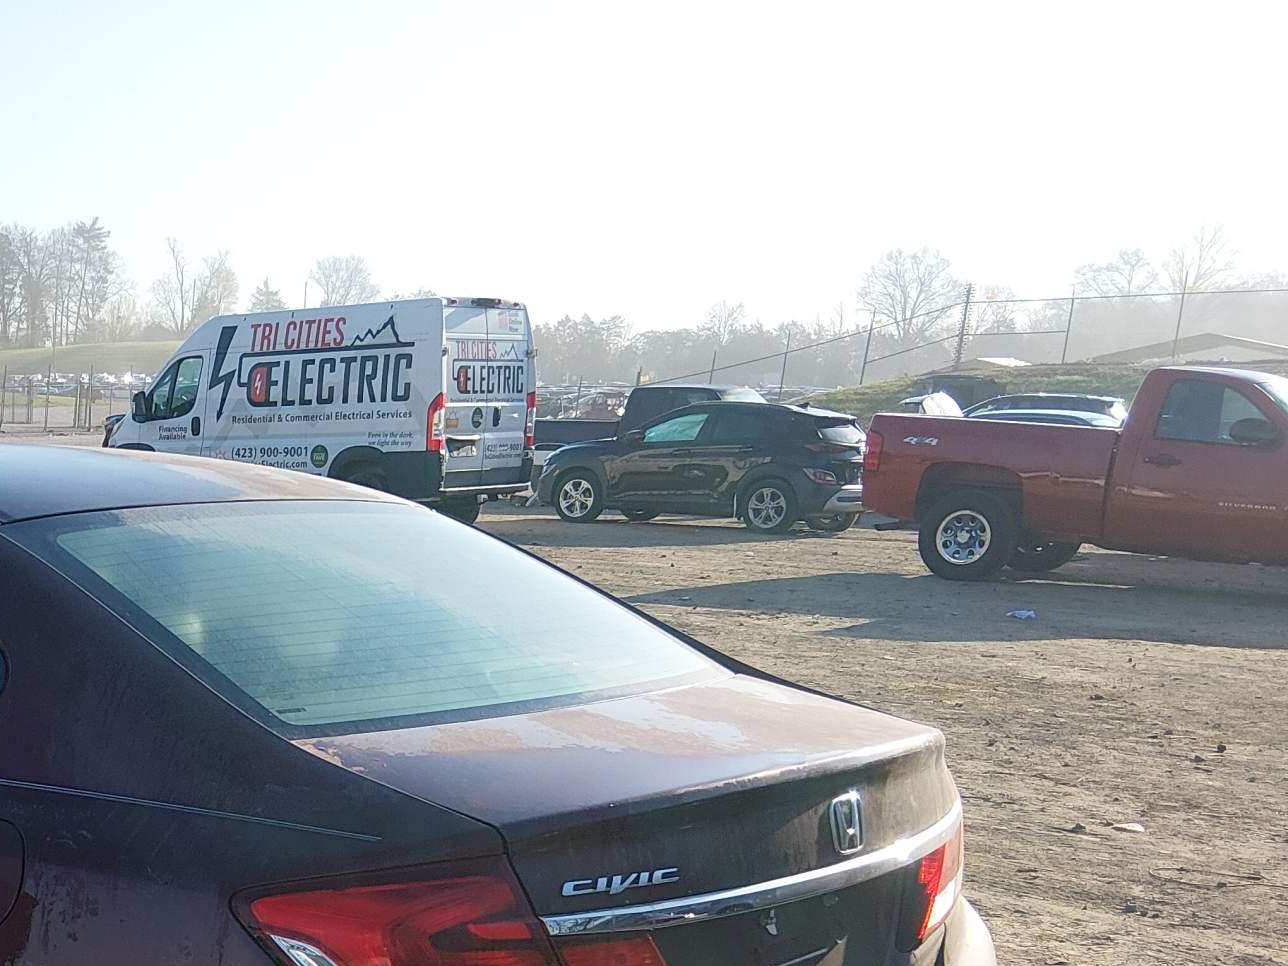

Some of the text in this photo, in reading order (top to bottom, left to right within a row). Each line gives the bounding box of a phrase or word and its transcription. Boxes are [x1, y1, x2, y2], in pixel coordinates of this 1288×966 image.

[250, 316, 347, 351] TRI CITIES
[456, 341, 497, 360] TRI CITIES
[247, 353, 413, 407] ELECTRIC
[457, 365, 523, 394] ELECTRIC
[232, 408, 412, 425] Residential & Commercial Electrical Services
[159, 425, 188, 433] Financing
[159, 432, 186, 440] Available
[232, 446, 308, 460] (423) 900-9001
[561, 867, 681, 897] CIVIC
